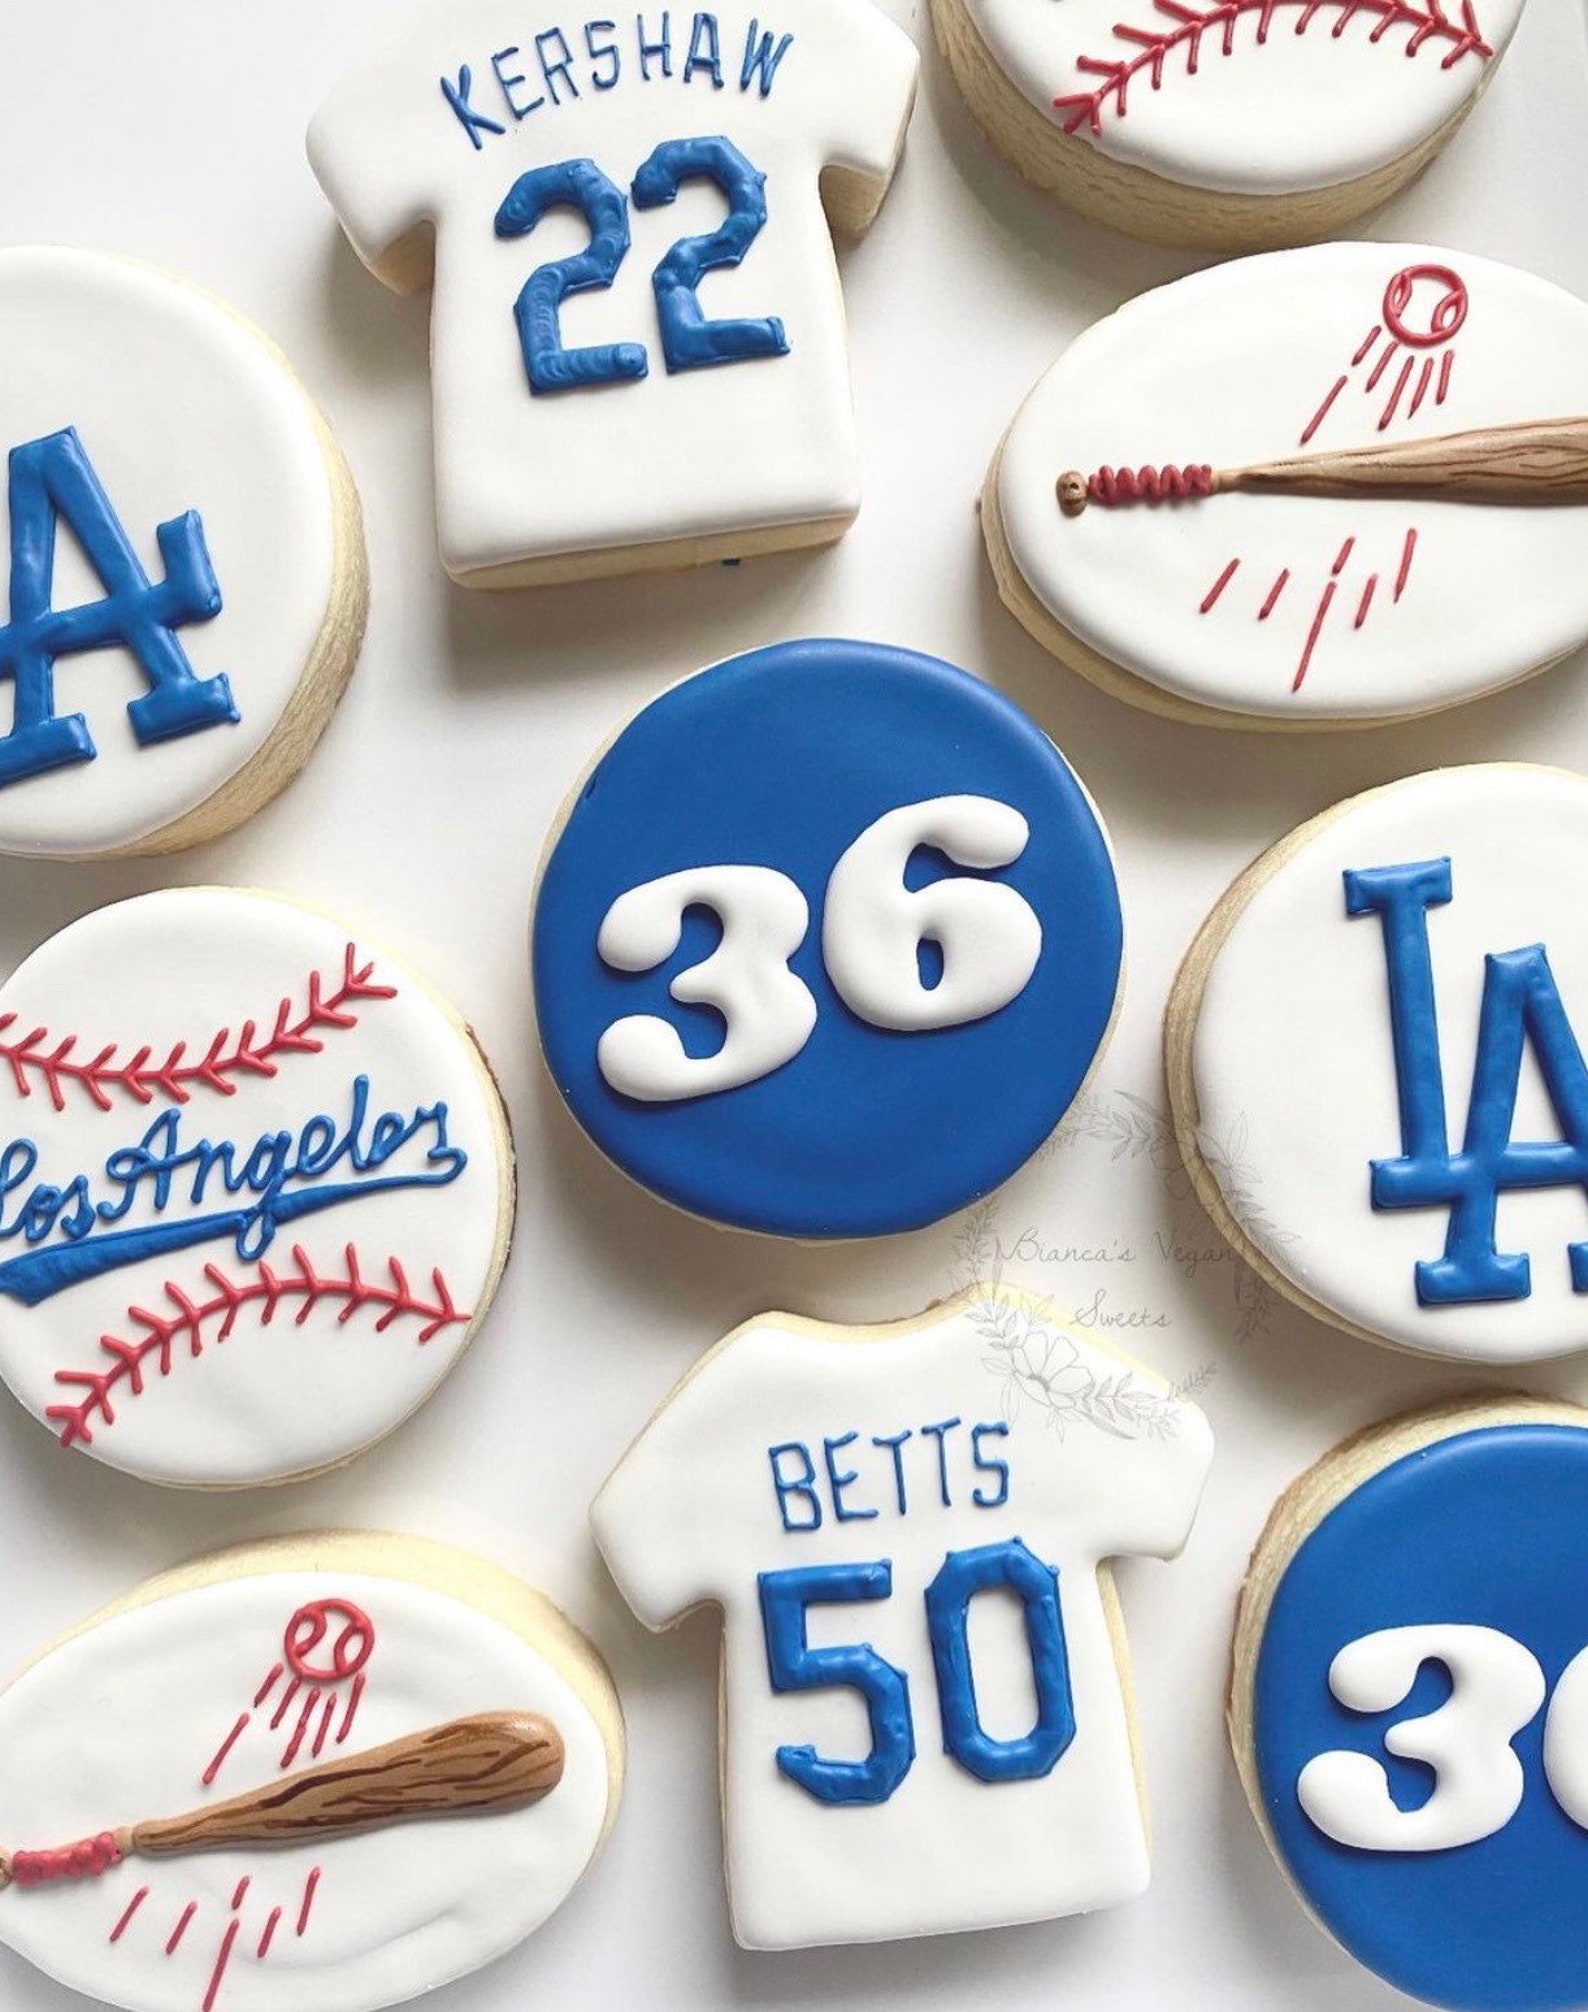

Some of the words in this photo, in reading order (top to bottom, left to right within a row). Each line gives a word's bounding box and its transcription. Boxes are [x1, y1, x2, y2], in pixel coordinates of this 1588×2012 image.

[441, 11, 793, 149] KERSHAW
[494, 135, 790, 395] 22
[598, 794, 1043, 1103] 36
[97, 1074, 468, 1261] Angeles
[768, 1417, 1010, 1532] BETTS
[757, 1536, 1076, 1807] 50
[1297, 1623, 1588, 1852] 3
